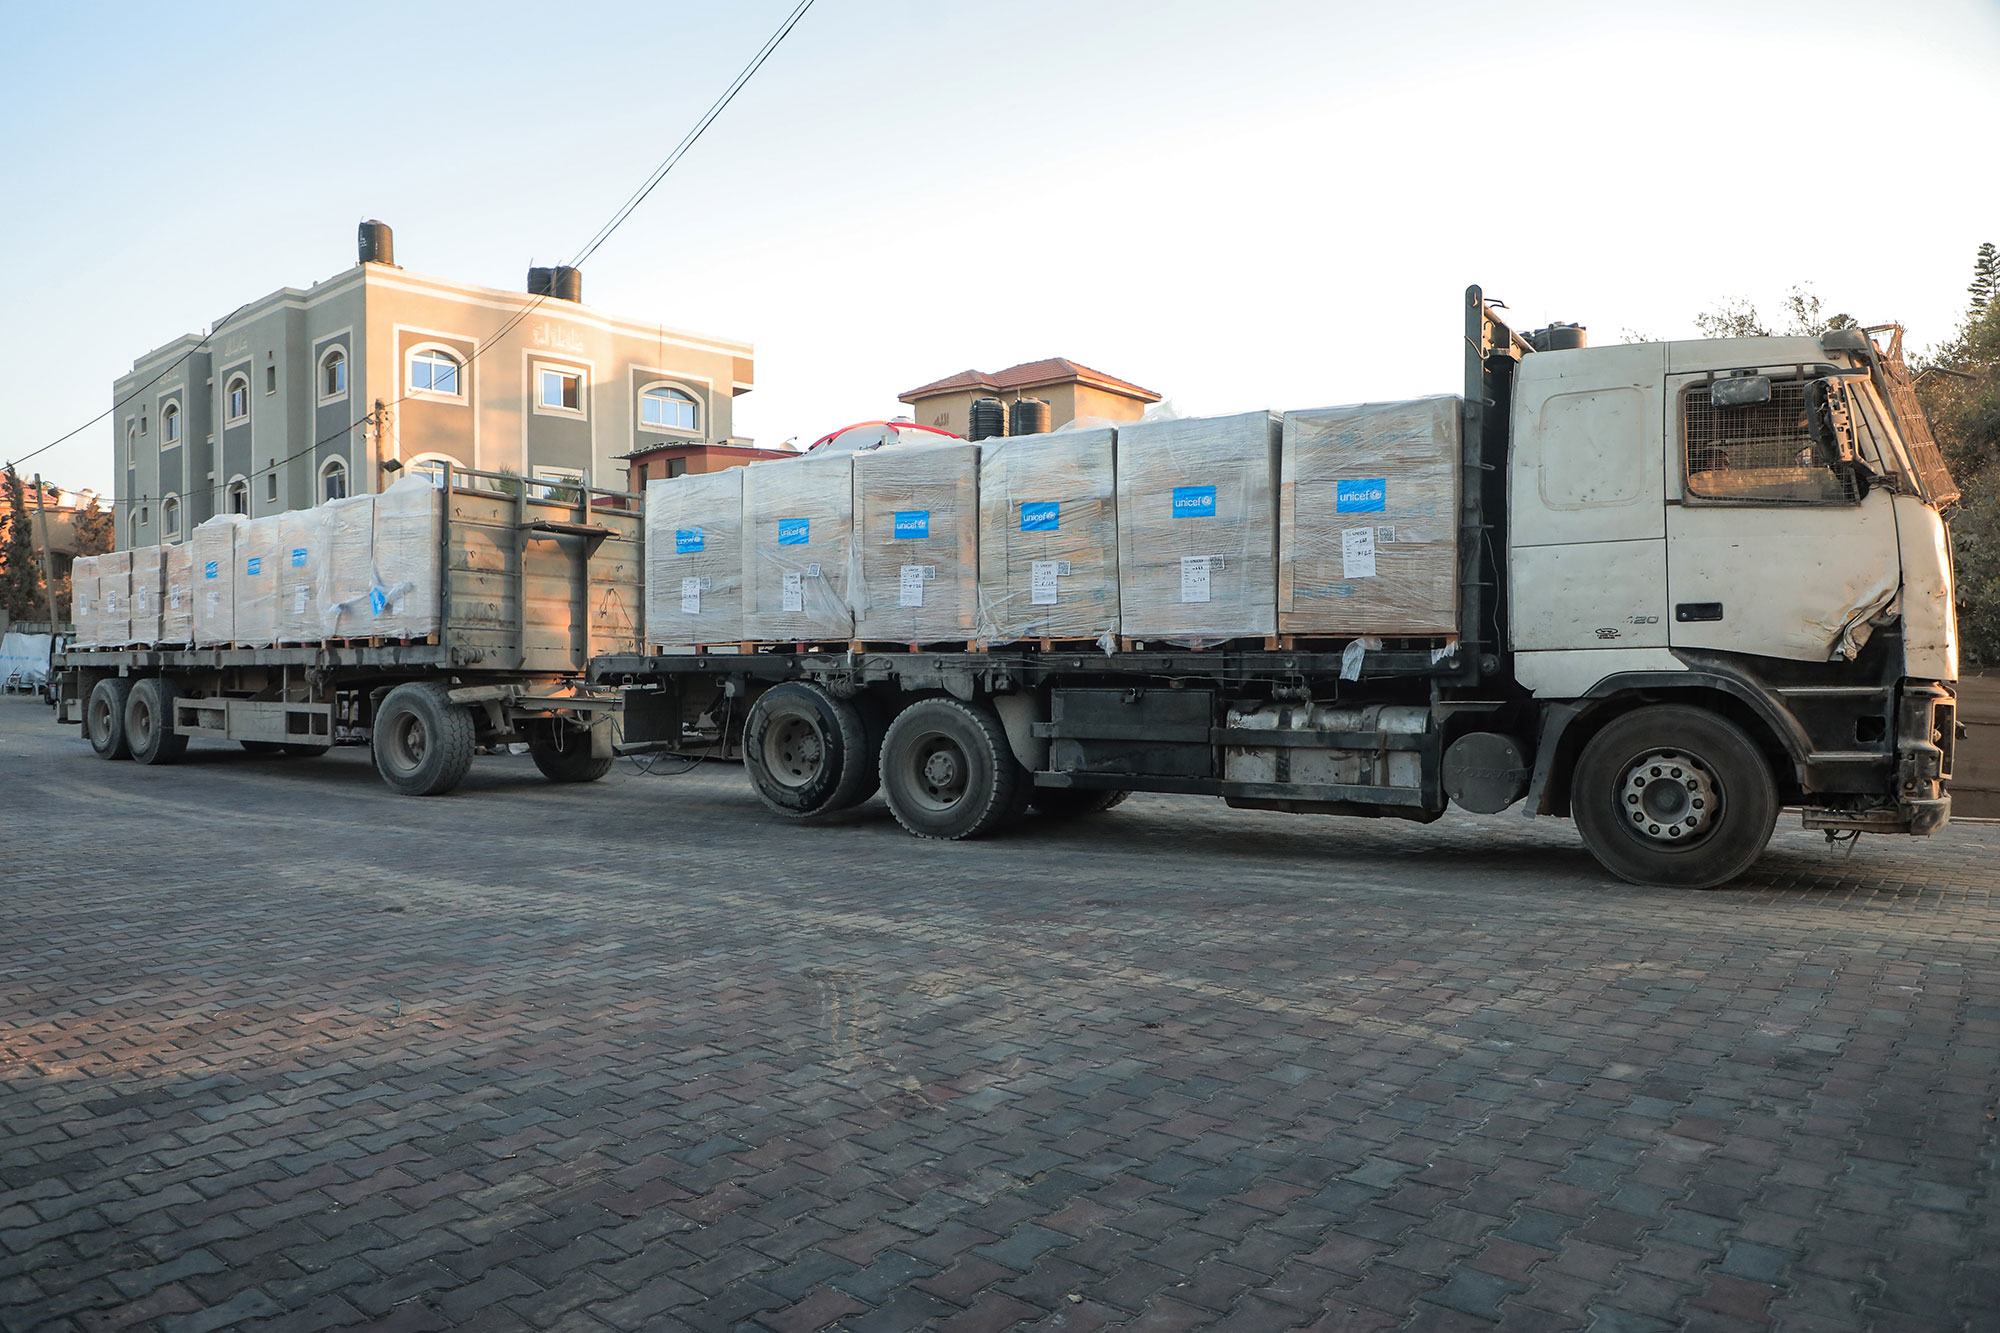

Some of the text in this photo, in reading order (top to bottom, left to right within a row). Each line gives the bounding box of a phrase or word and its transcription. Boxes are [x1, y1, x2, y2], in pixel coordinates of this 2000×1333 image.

[1175, 496, 1201, 507] unicef
[1339, 490, 1370, 502] unicef
[1023, 511, 1047, 522] unicef
[896, 520, 917, 530] unicef
[780, 527, 799, 537] unicef
